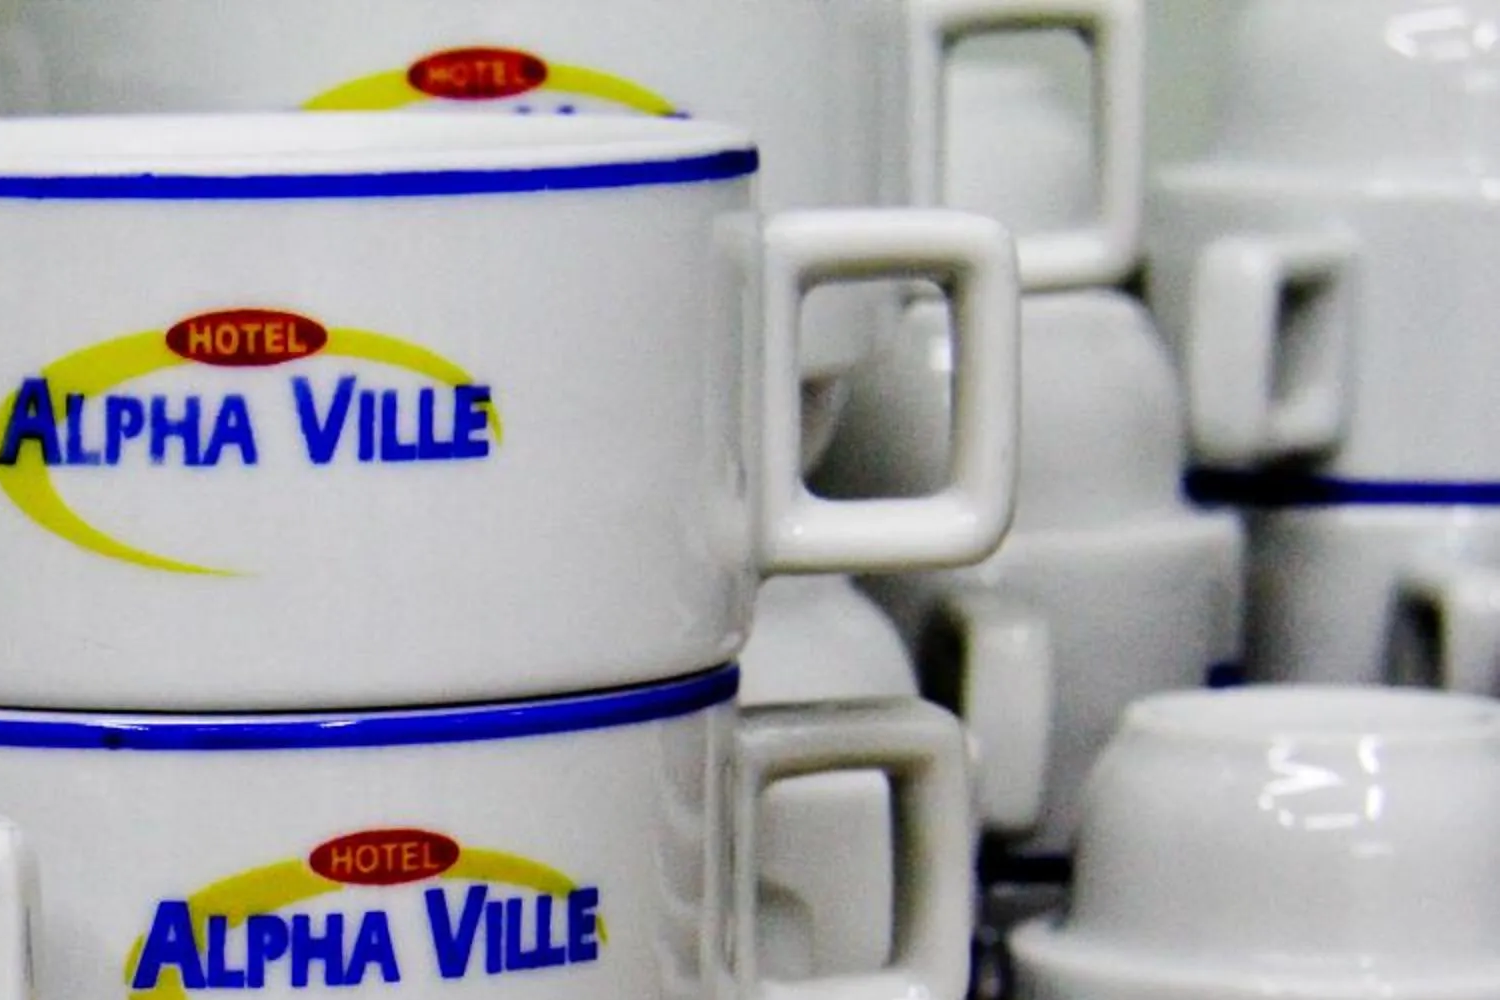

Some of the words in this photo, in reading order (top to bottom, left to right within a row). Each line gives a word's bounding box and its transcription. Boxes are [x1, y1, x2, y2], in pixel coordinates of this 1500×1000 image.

[427, 60, 526, 88] HOTEL
[187, 320, 308, 356] HOTEL
[290, 375, 492, 466] VILLE
[330, 840, 441, 874] HOTEL
[132, 899, 401, 990] ALPHA
[423, 884, 600, 980] VILLE
